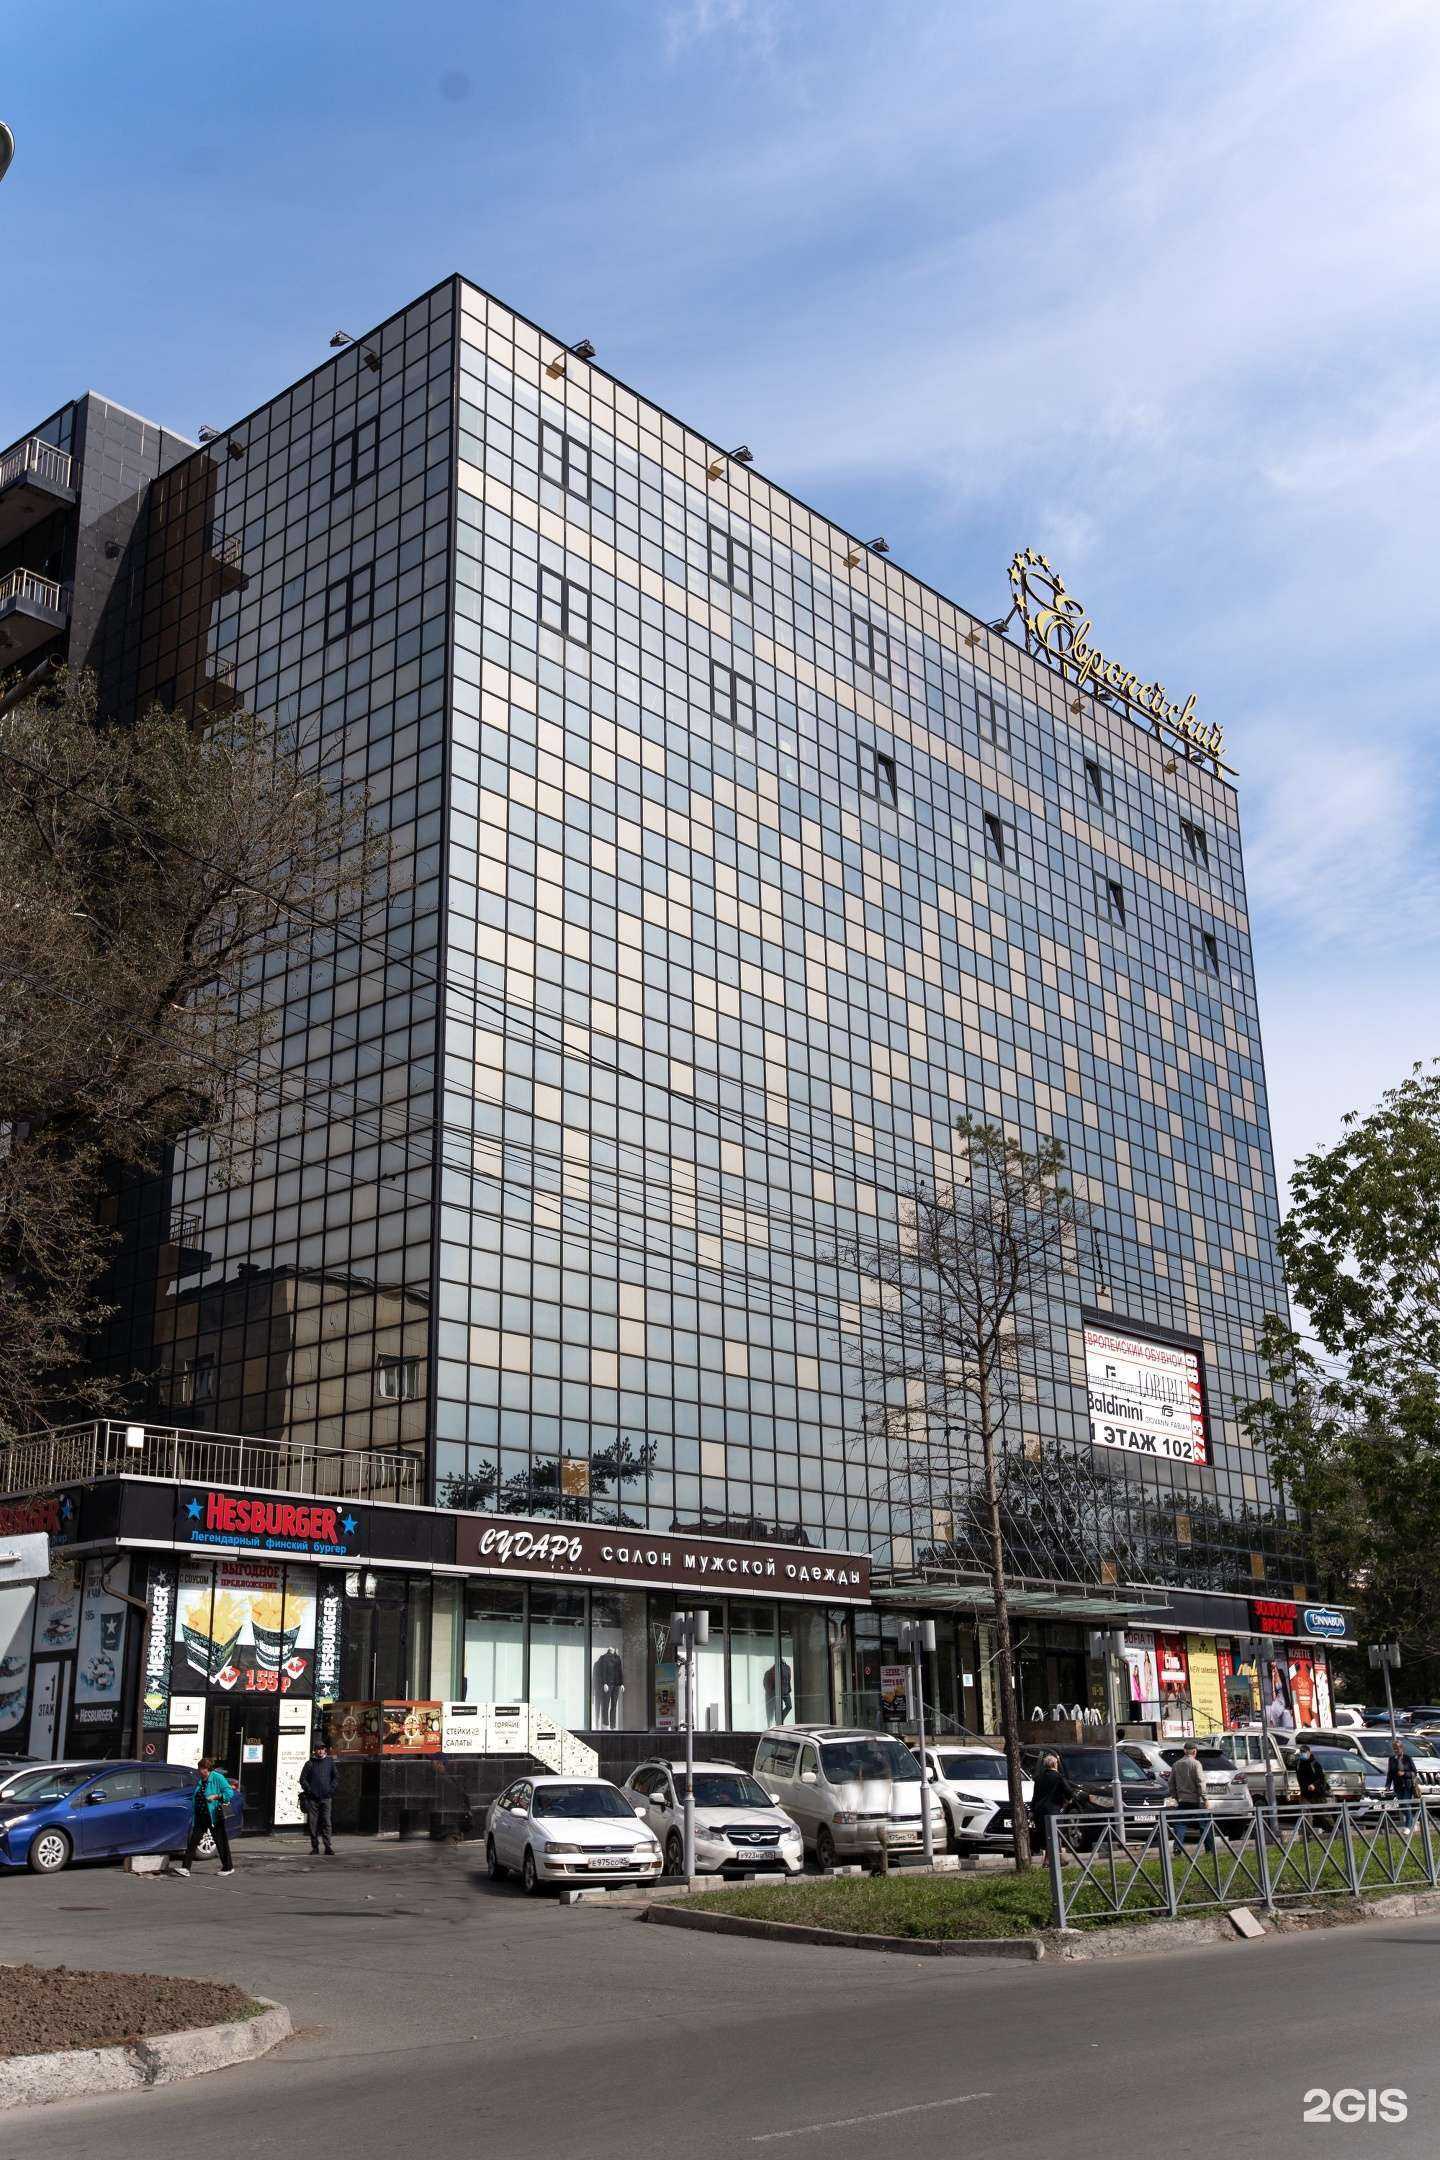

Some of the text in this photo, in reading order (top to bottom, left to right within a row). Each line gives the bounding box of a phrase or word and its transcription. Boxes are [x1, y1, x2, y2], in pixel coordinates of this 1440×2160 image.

[1088, 1391, 1143, 1421] Baldinini
[1104, 1425, 1156, 1453] ЭТАЖ
[1162, 1438, 1192, 1459] 102
[206, 1492, 338, 1544] HESBURGER
[190, 1530, 347, 1555] Легендарный финский бургер
[479, 1528, 583, 1564] СУДАРЬ
[221, 1562, 280, 1578] ВЫГОДНОЕ
[600, 1546, 860, 1585] салон мужской одежды
[146, 1583, 170, 1677] HESBURGER
[319, 1596, 339, 1681] HESBURGER
[245, 1670, 279, 1691] 155
[80, 1708, 114, 1723] HESBURGER
